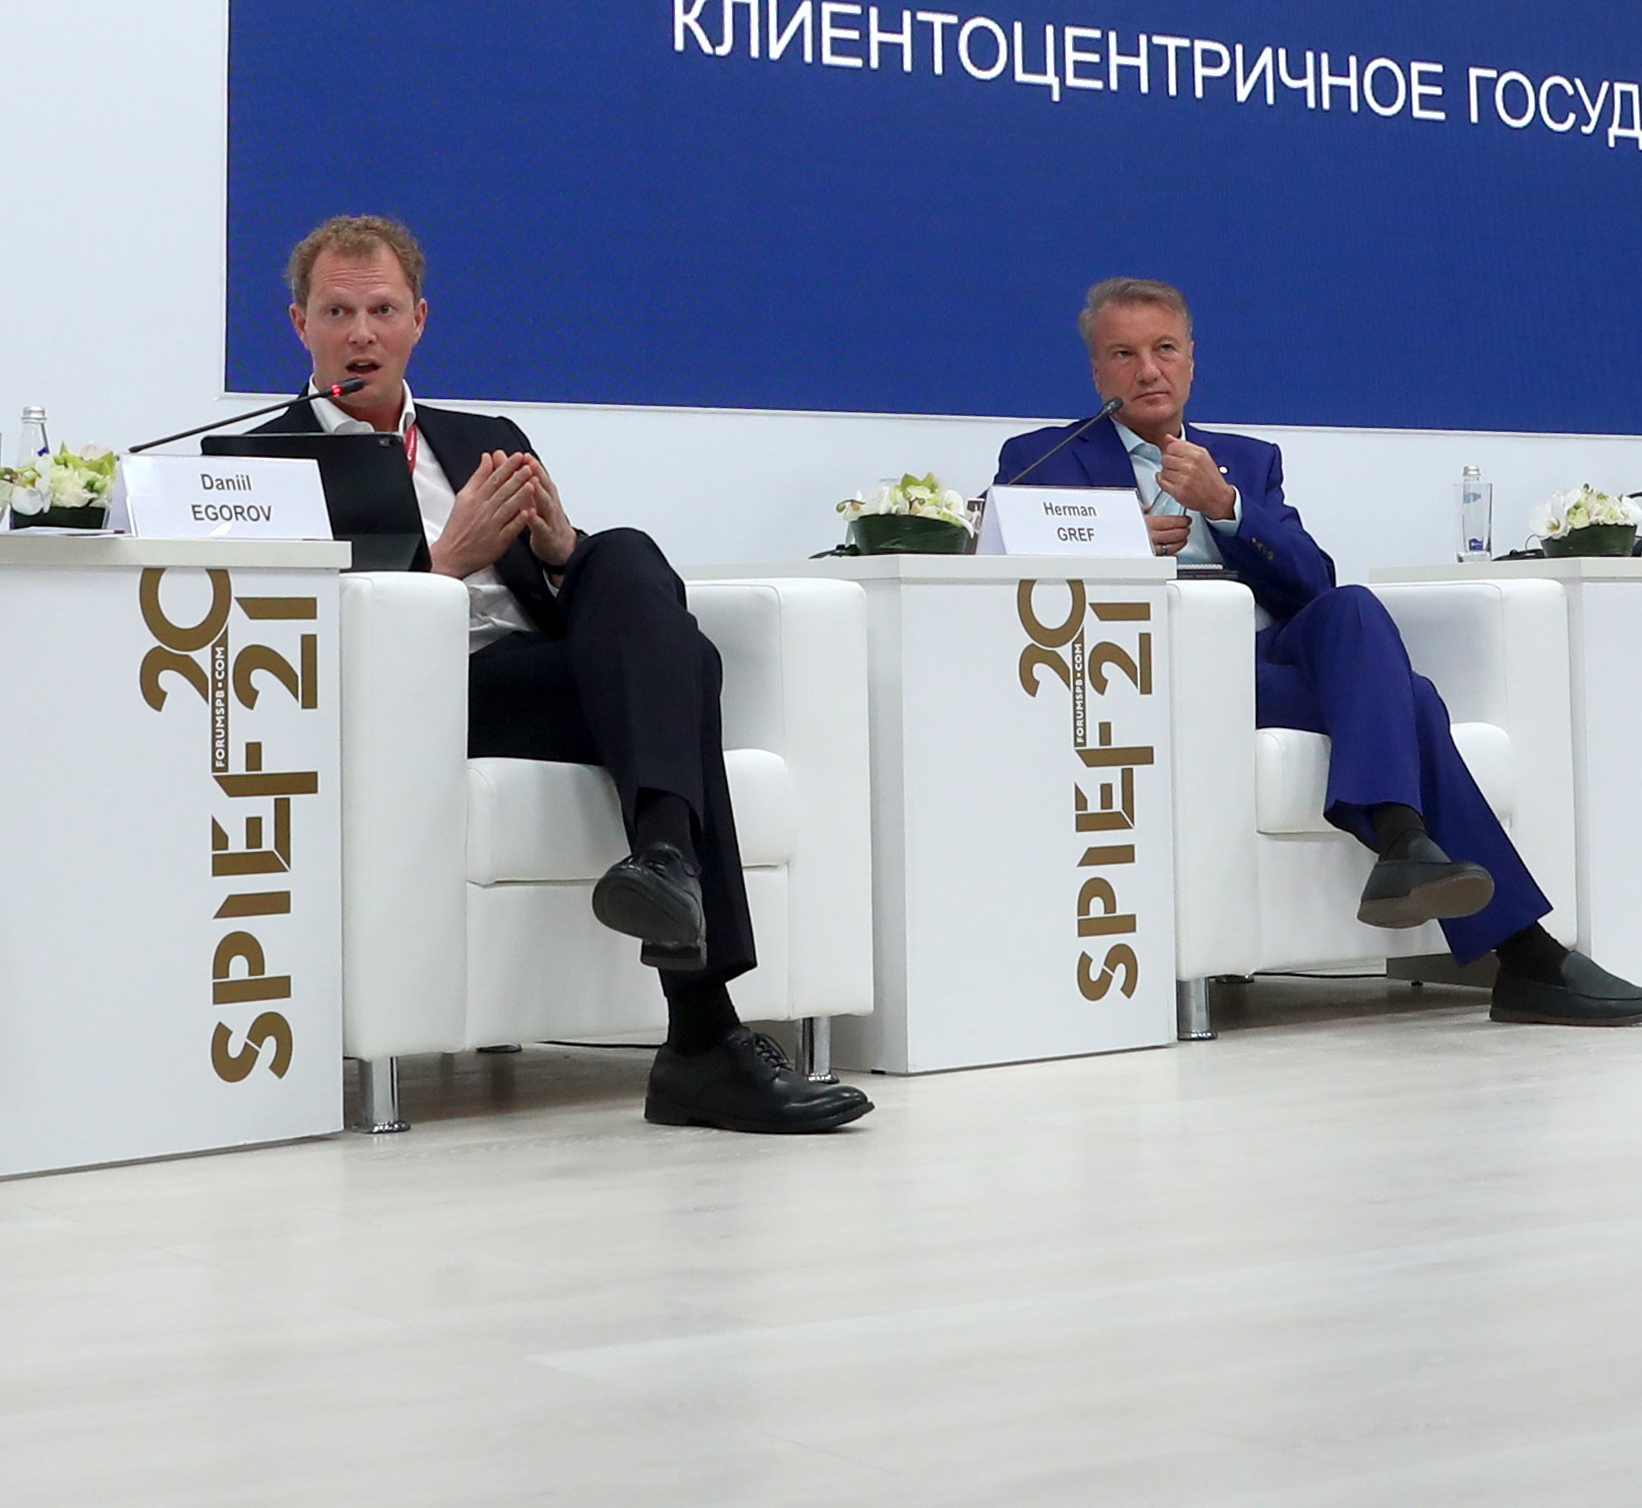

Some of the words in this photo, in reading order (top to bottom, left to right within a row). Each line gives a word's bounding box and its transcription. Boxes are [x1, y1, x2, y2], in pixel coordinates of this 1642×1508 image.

[200, 473, 253, 492] Daniil
[1042, 501, 1097, 517] Herman
[191, 503, 273, 522] EGOROV
[1057, 527, 1095, 542] GREF
[232, 596, 318, 710] 21
[1088, 602, 1153, 695] 21
[1074, 721, 1155, 1002] SPIEF
[211, 741, 319, 1083] SPIEF
